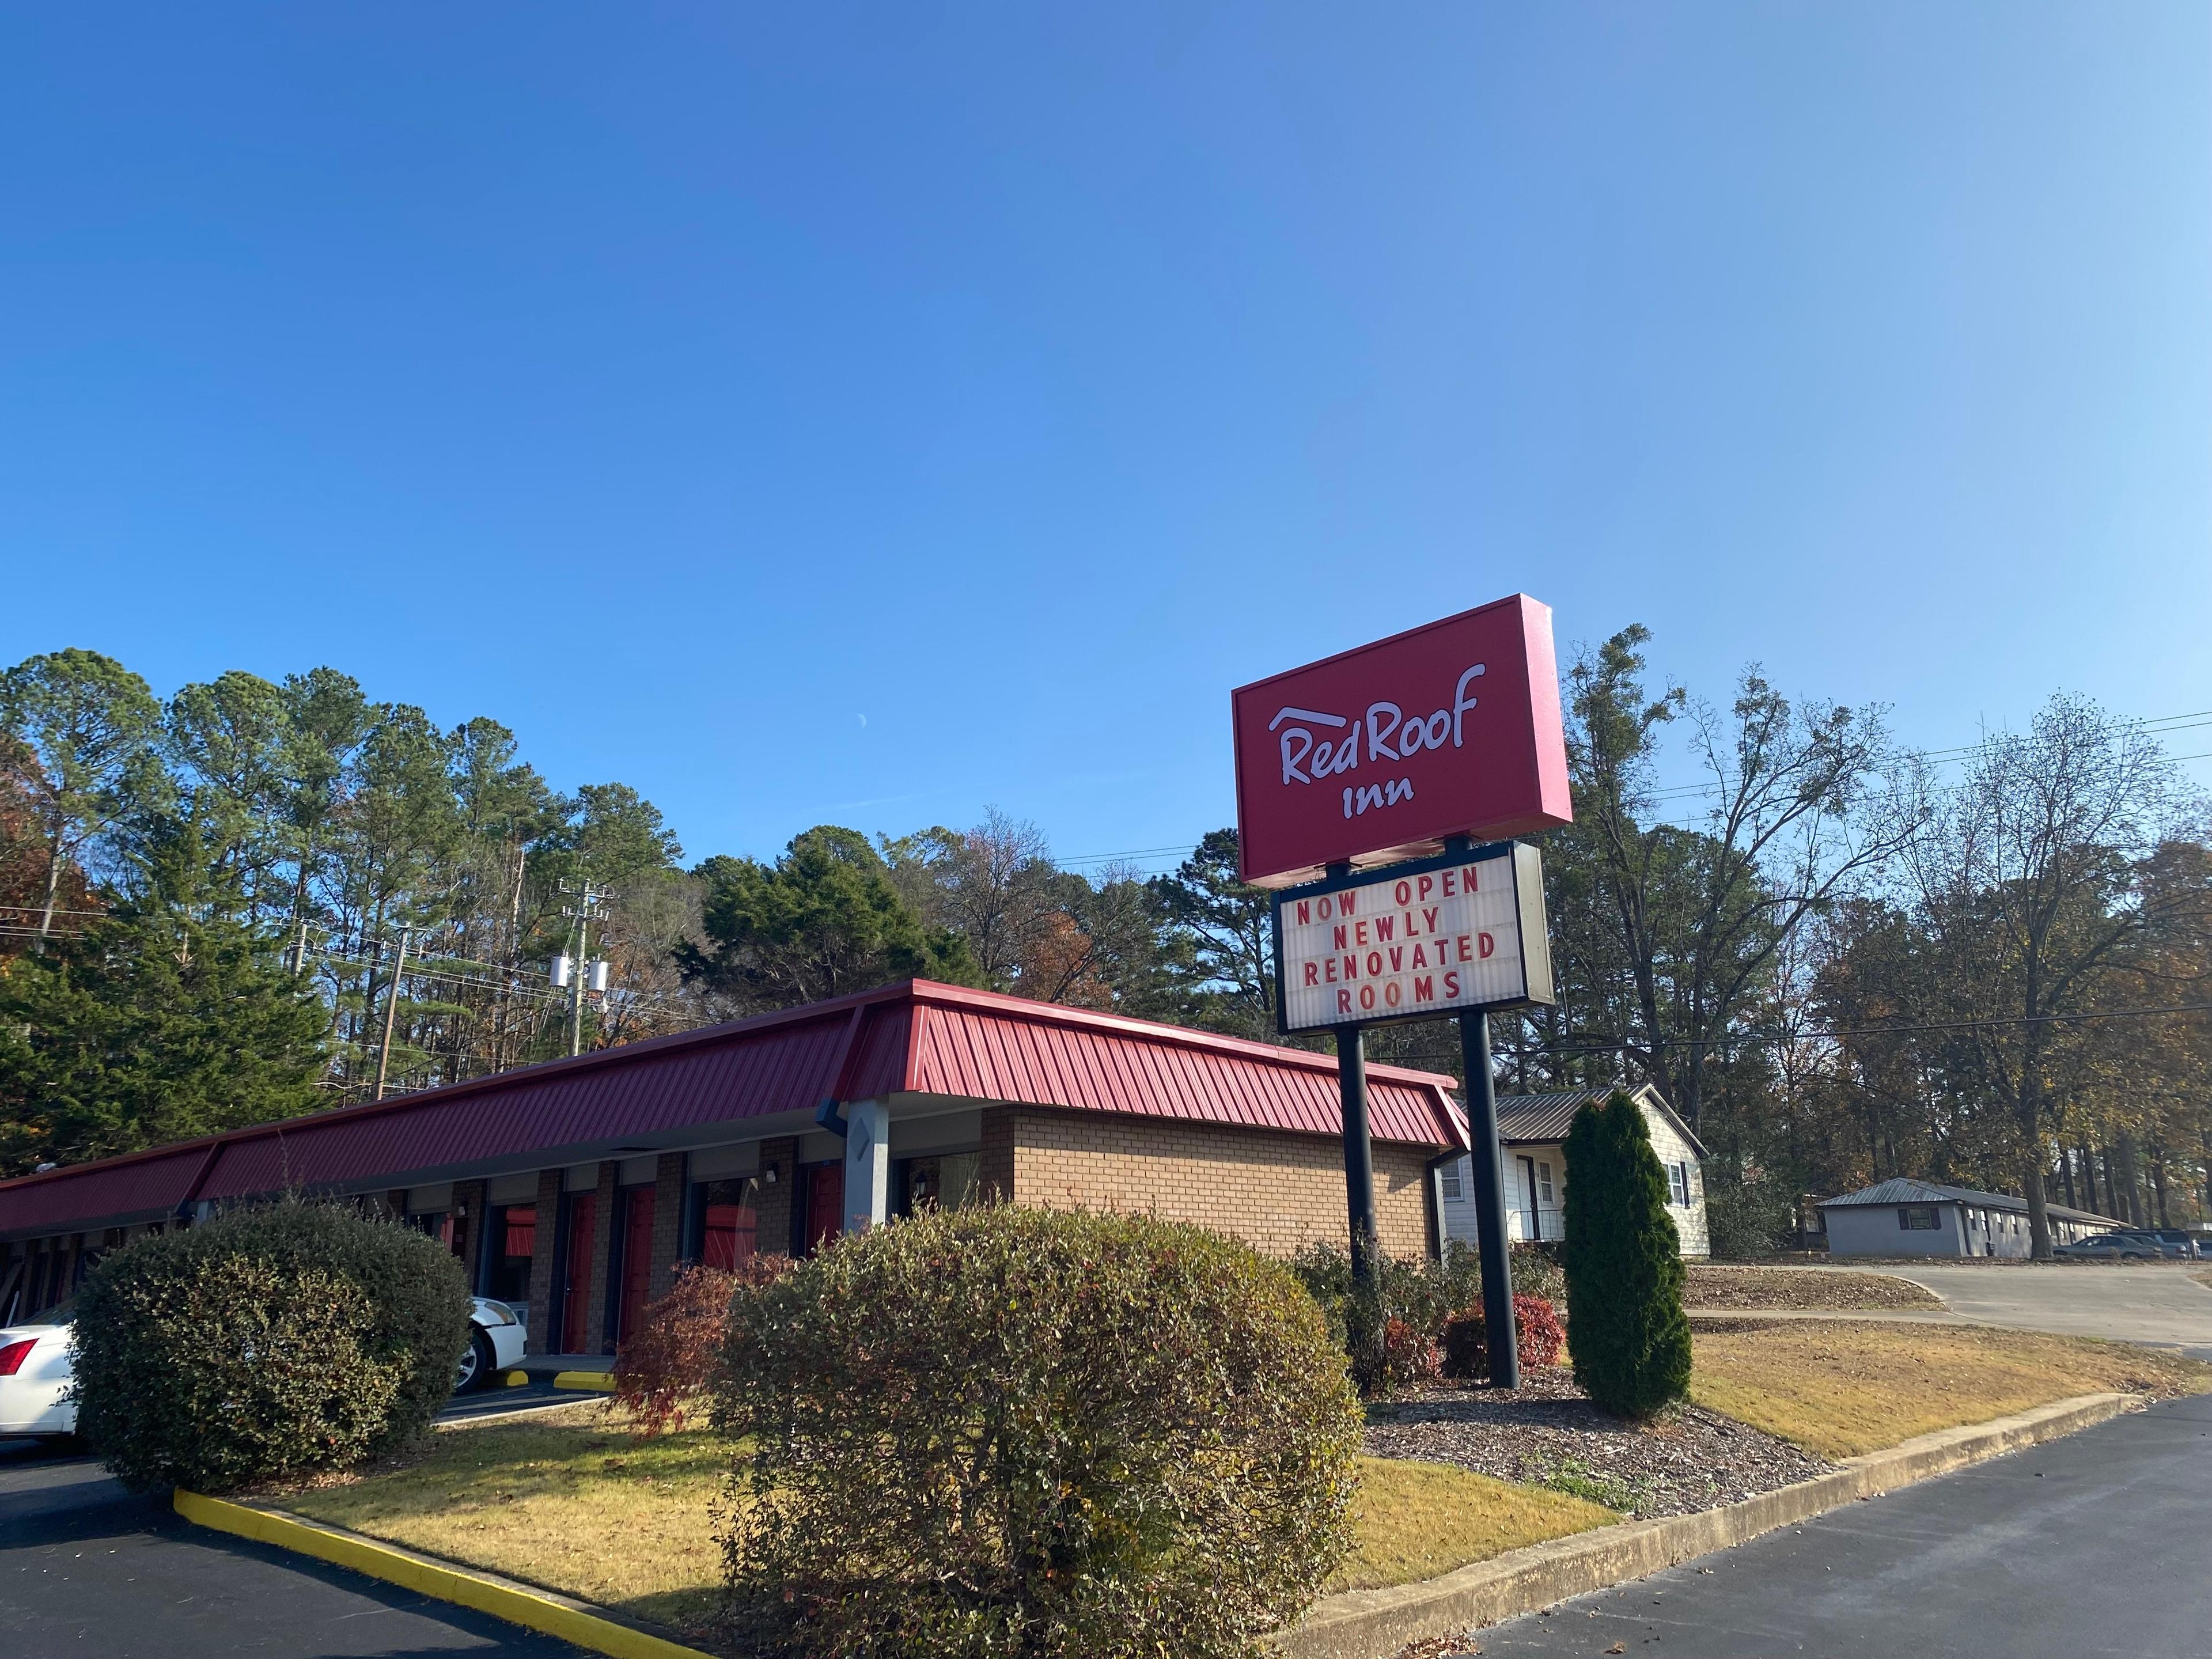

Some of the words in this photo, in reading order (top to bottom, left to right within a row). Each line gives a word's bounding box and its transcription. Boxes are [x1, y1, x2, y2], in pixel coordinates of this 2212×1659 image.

[1279, 719, 1361, 785] Red
[1366, 662, 1486, 762] Roof
[1297, 891, 1355, 926] NOW
[1395, 866, 1478, 906] OPEN
[1334, 906, 1438, 950] NEWLY
[1304, 931, 1494, 986] RENOVATED
[1336, 971, 1460, 1014] ROOMS
